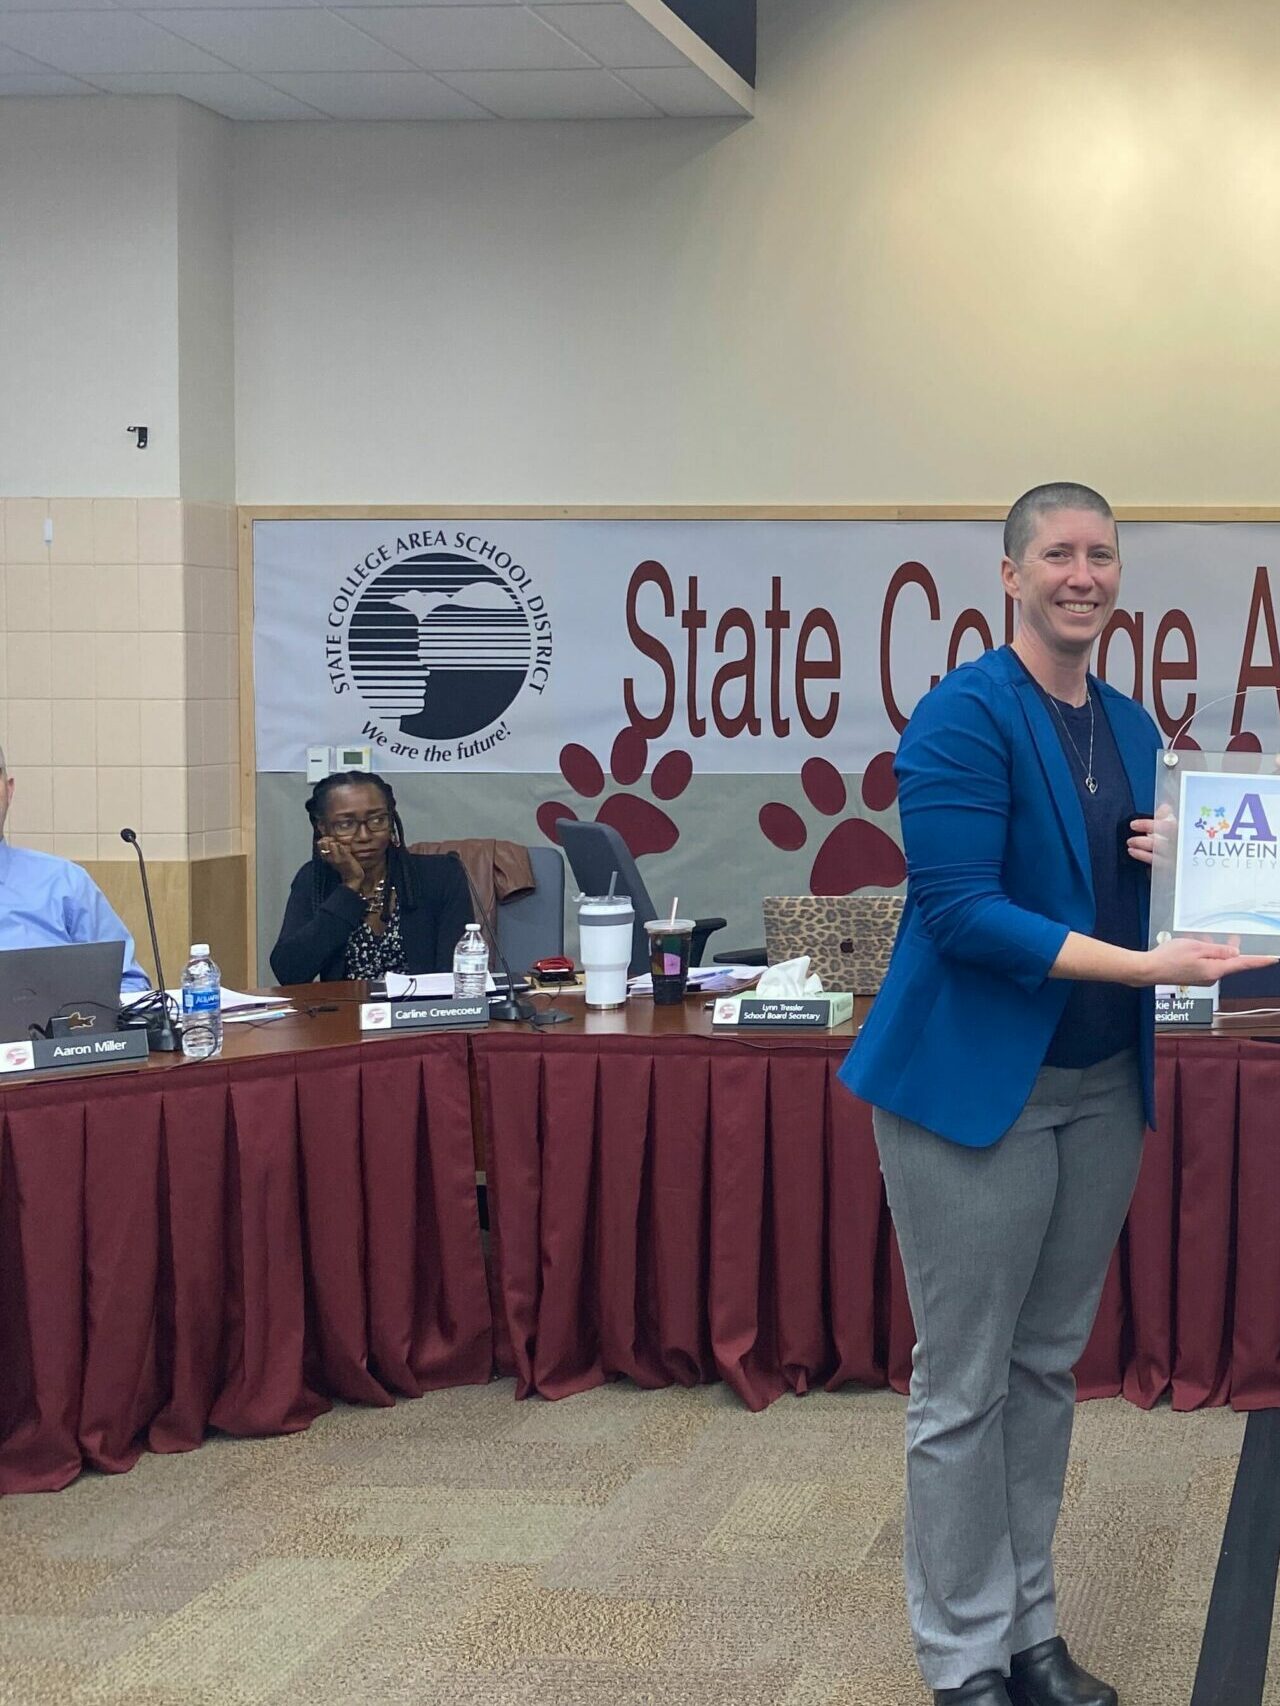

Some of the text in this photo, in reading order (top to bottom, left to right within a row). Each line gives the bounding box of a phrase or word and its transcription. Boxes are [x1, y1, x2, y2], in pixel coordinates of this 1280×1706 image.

[326, 530, 553, 695] STATE COLLEGE AREA SCHOOL DISTRICT
[623, 560, 842, 739] State
[361, 720, 511, 762] We are the future!
[1223, 793, 1277, 842] A
[1193, 841, 1277, 859] ALLWEIN
[1192, 857, 1277, 869] SOCIETY
[762, 1004, 778, 1012] Lynn
[1155, 1000, 1195, 1009] kie Huff
[395, 1006, 483, 1020] Carline Crevecoeur
[744, 1012, 820, 1022] School Board Secretary
[1155, 1011, 1189, 1021] esident
[53, 1039, 127, 1058] Aaron Miller
